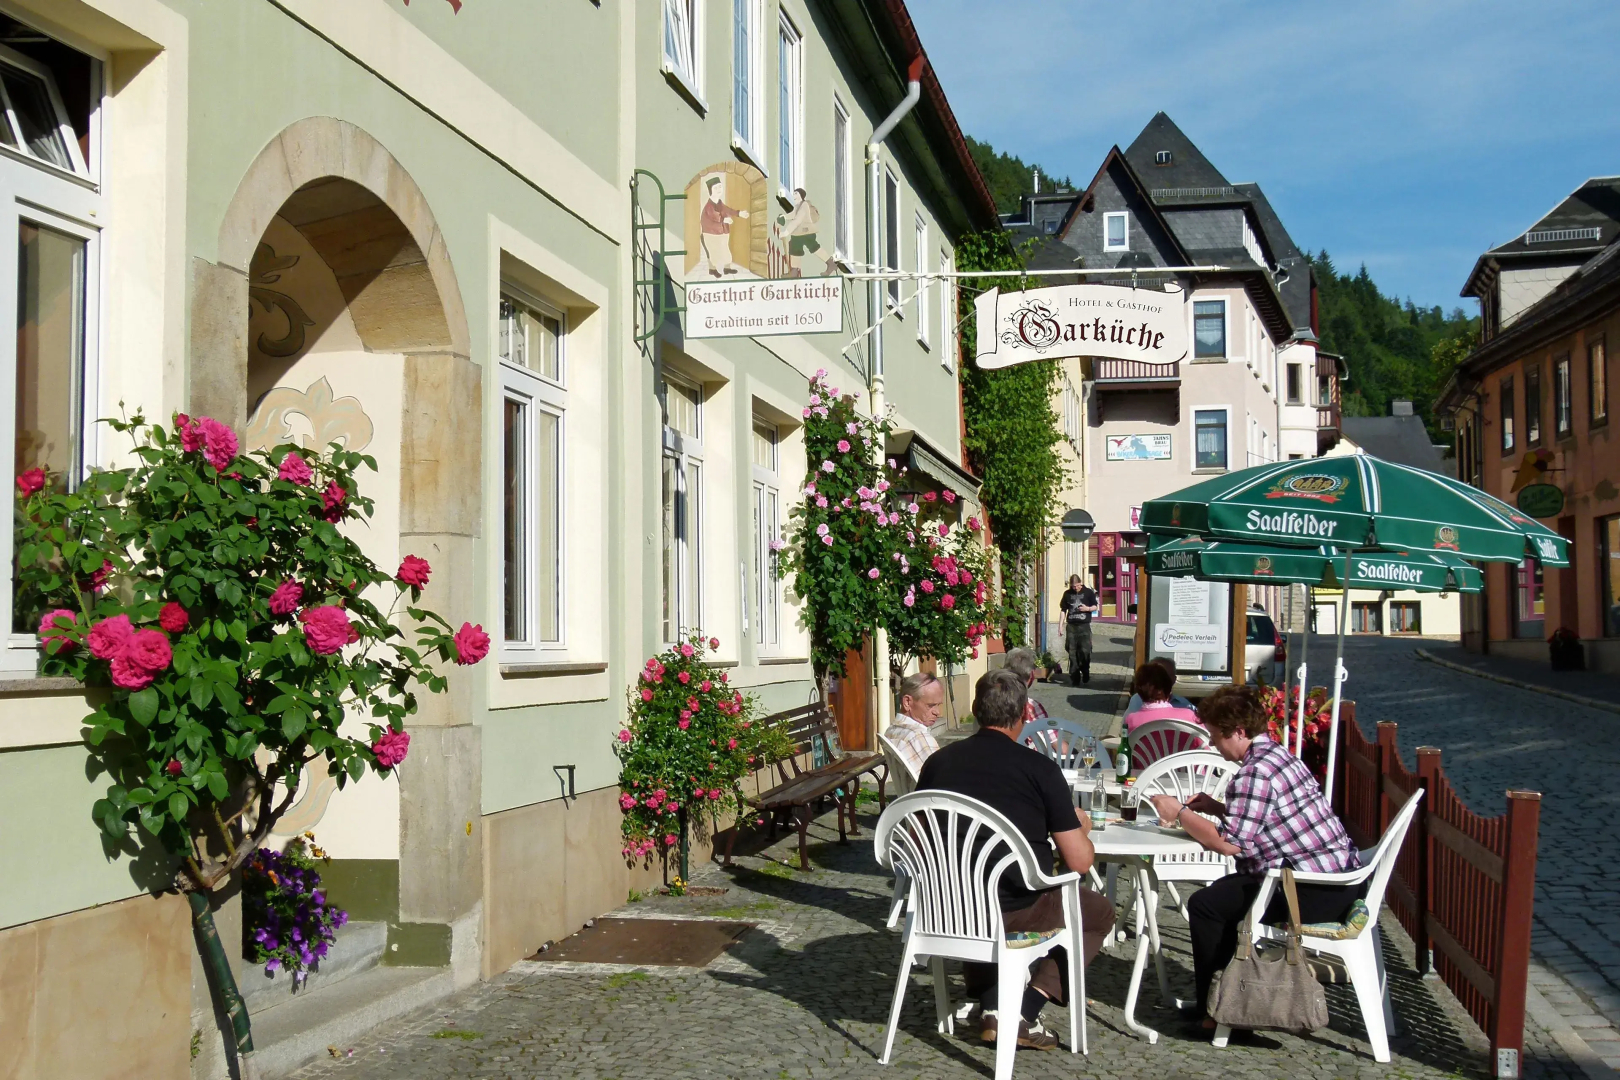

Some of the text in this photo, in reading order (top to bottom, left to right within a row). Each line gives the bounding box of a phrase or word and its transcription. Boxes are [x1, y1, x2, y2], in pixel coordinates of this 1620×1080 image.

[688, 283, 840, 306] Gasthof Garküche
[705, 312, 823, 329] Tradition seit 1650
[998, 299, 1165, 354] Garküche
[1246, 509, 1337, 537] Saalfelder
[1161, 551, 1194, 569] Saalfelder
[1357, 561, 1423, 583] Saalfelder
